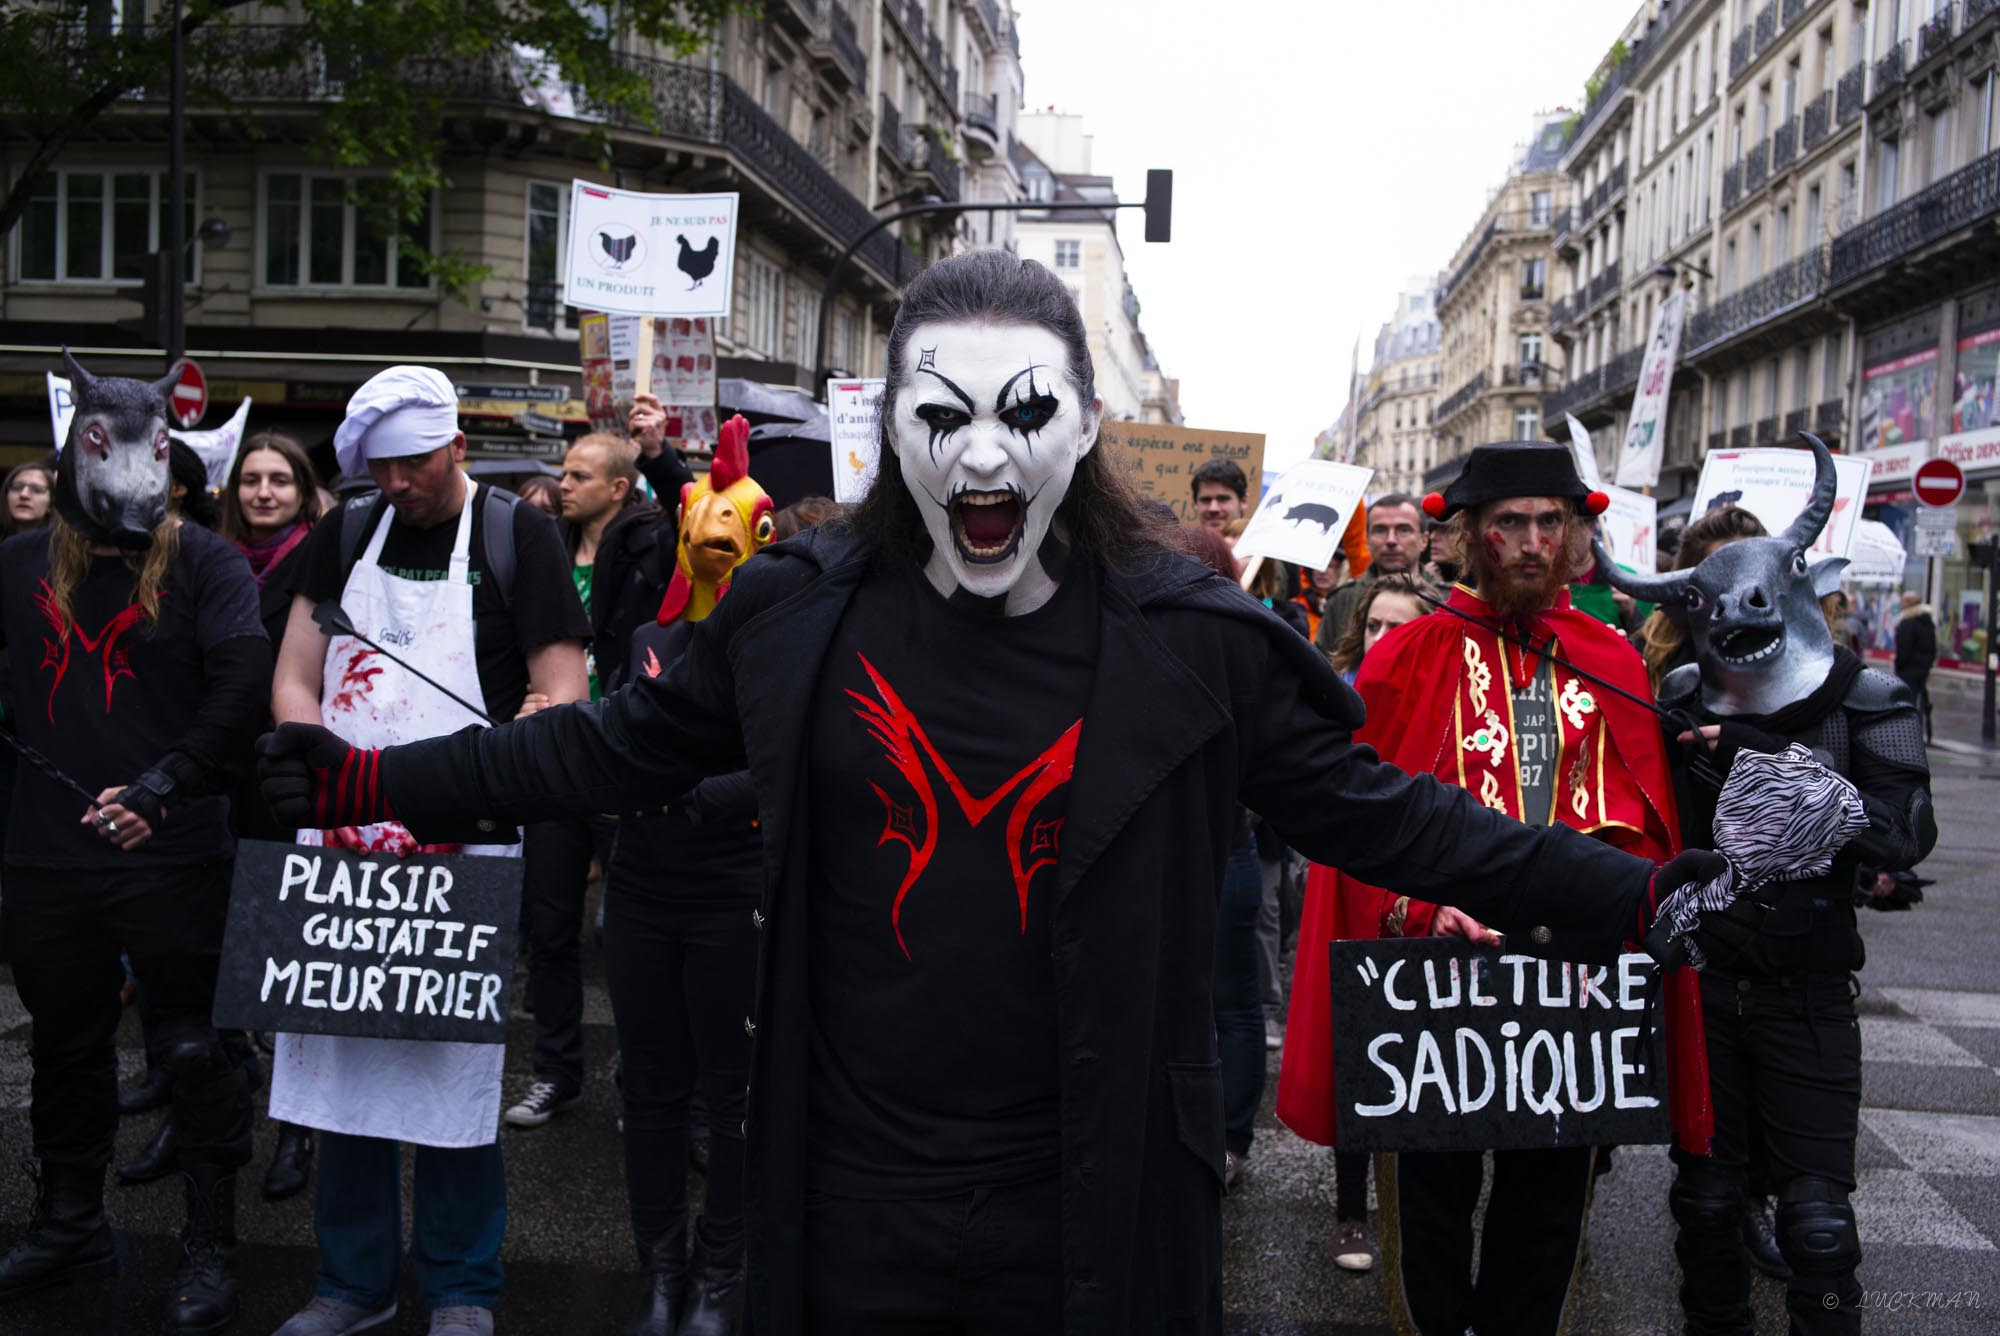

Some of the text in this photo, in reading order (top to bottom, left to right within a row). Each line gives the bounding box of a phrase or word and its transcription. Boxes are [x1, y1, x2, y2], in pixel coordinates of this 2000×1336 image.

[708, 216, 728, 225] PAS
[577, 276, 656, 296] UN PRODUIT
[278, 853, 454, 914] PLAISIR
[302, 912, 499, 962] GUSTATIF
[260, 956, 503, 1024] MEURTRIER
